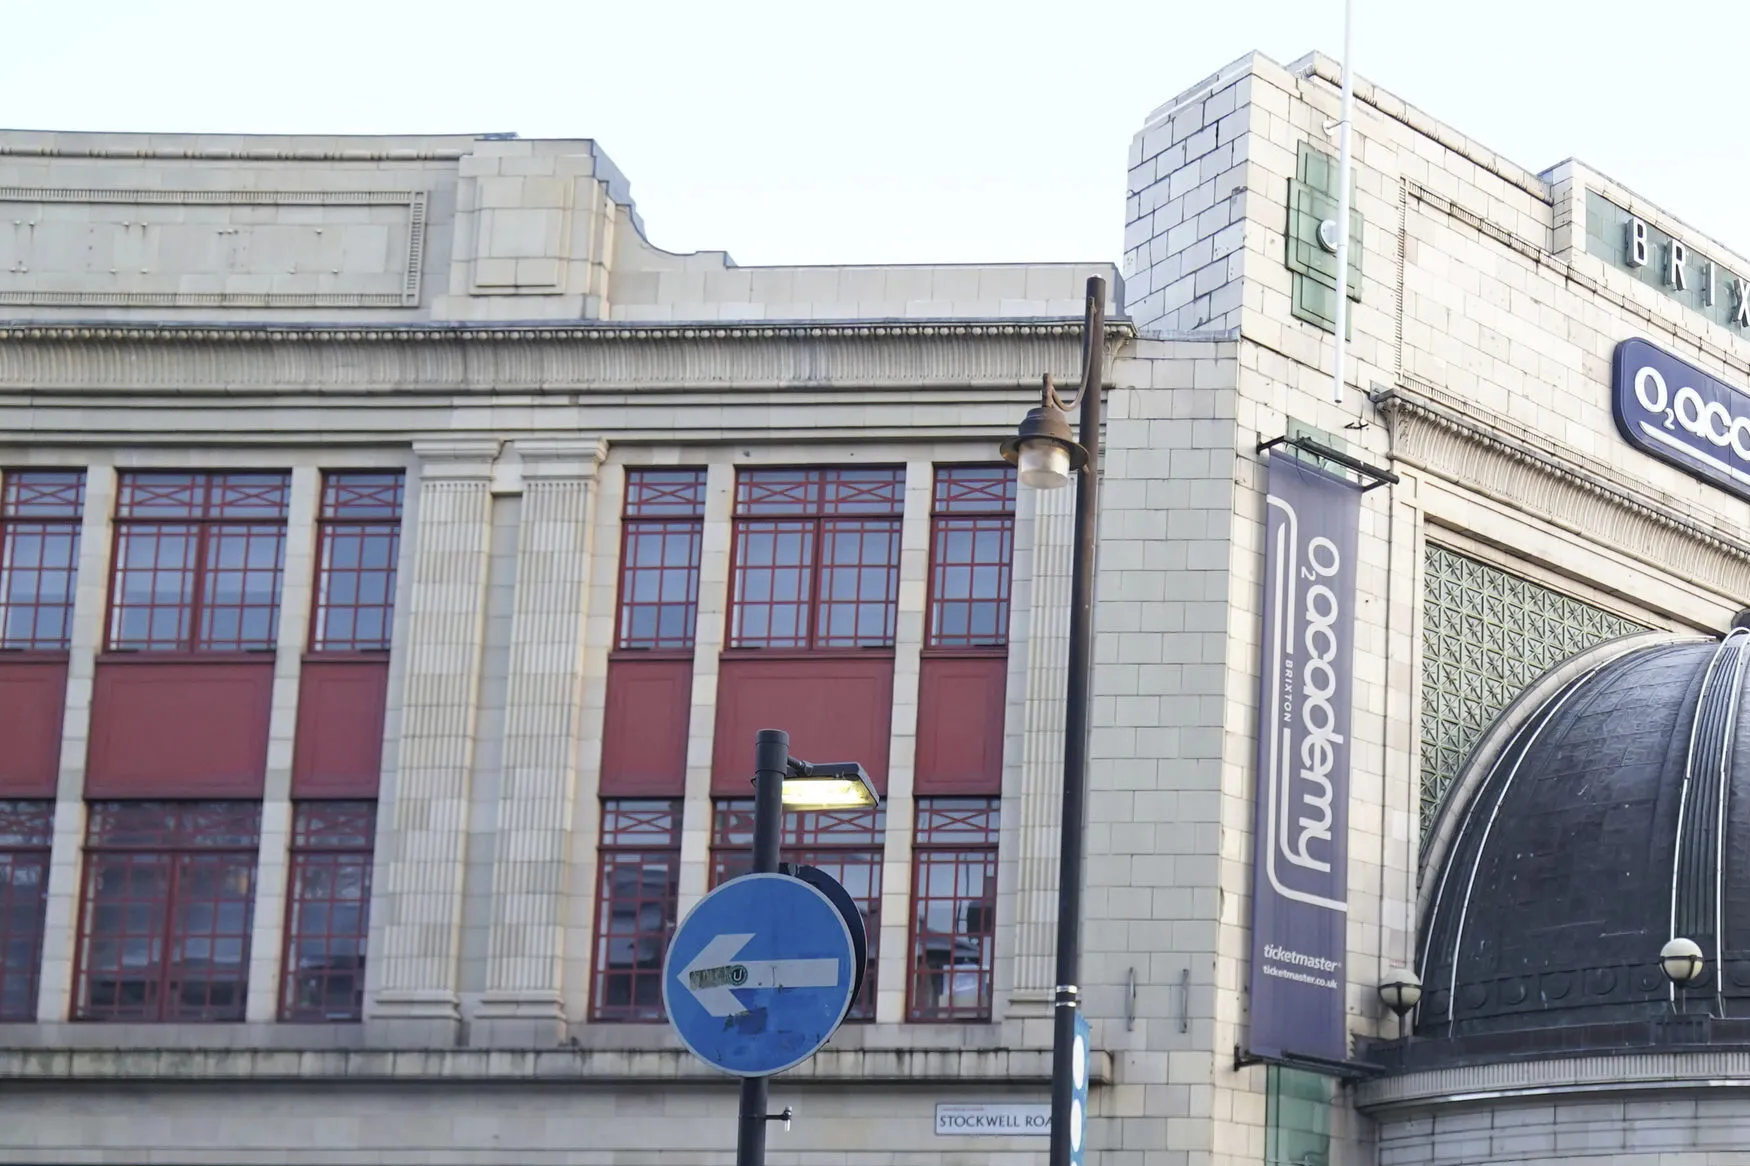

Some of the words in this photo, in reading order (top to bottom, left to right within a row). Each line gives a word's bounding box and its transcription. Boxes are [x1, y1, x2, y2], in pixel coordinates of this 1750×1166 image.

[1283, 658, 1295, 723] BRIXTON
[1263, 943, 1339, 973] ticketmaster
[1262, 964, 1338, 989] ticketmaster.co.uk
[939, 1114, 1021, 1129] STOCKWELL
[1025, 1114, 1053, 1129] ROA
